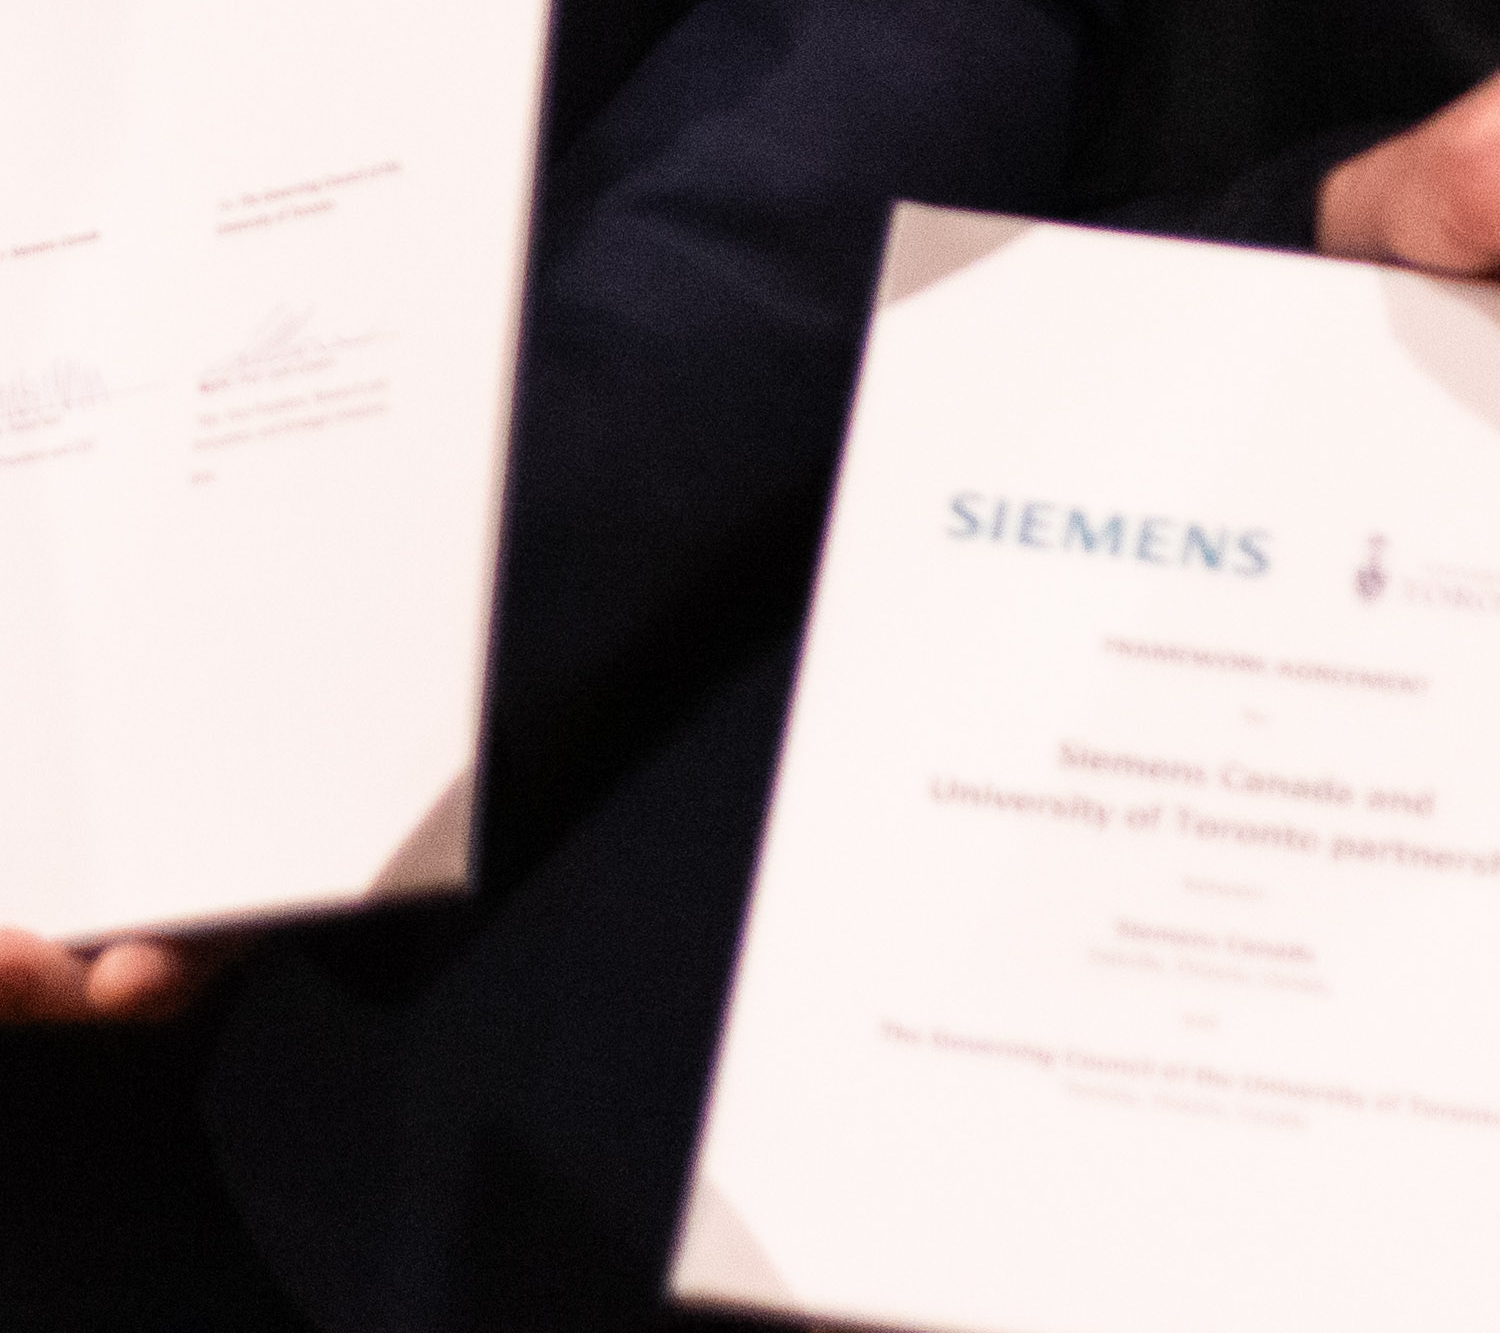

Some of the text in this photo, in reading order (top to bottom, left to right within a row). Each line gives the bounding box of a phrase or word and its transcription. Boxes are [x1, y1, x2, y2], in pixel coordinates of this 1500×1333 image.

[944, 489, 1273, 577] SIEMENS
[929, 775, 1112, 829] University
[1125, 804, 1162, 830] of
[1175, 808, 1320, 851] Toronto
[1059, 741, 1434, 818] Siemens Canada and
